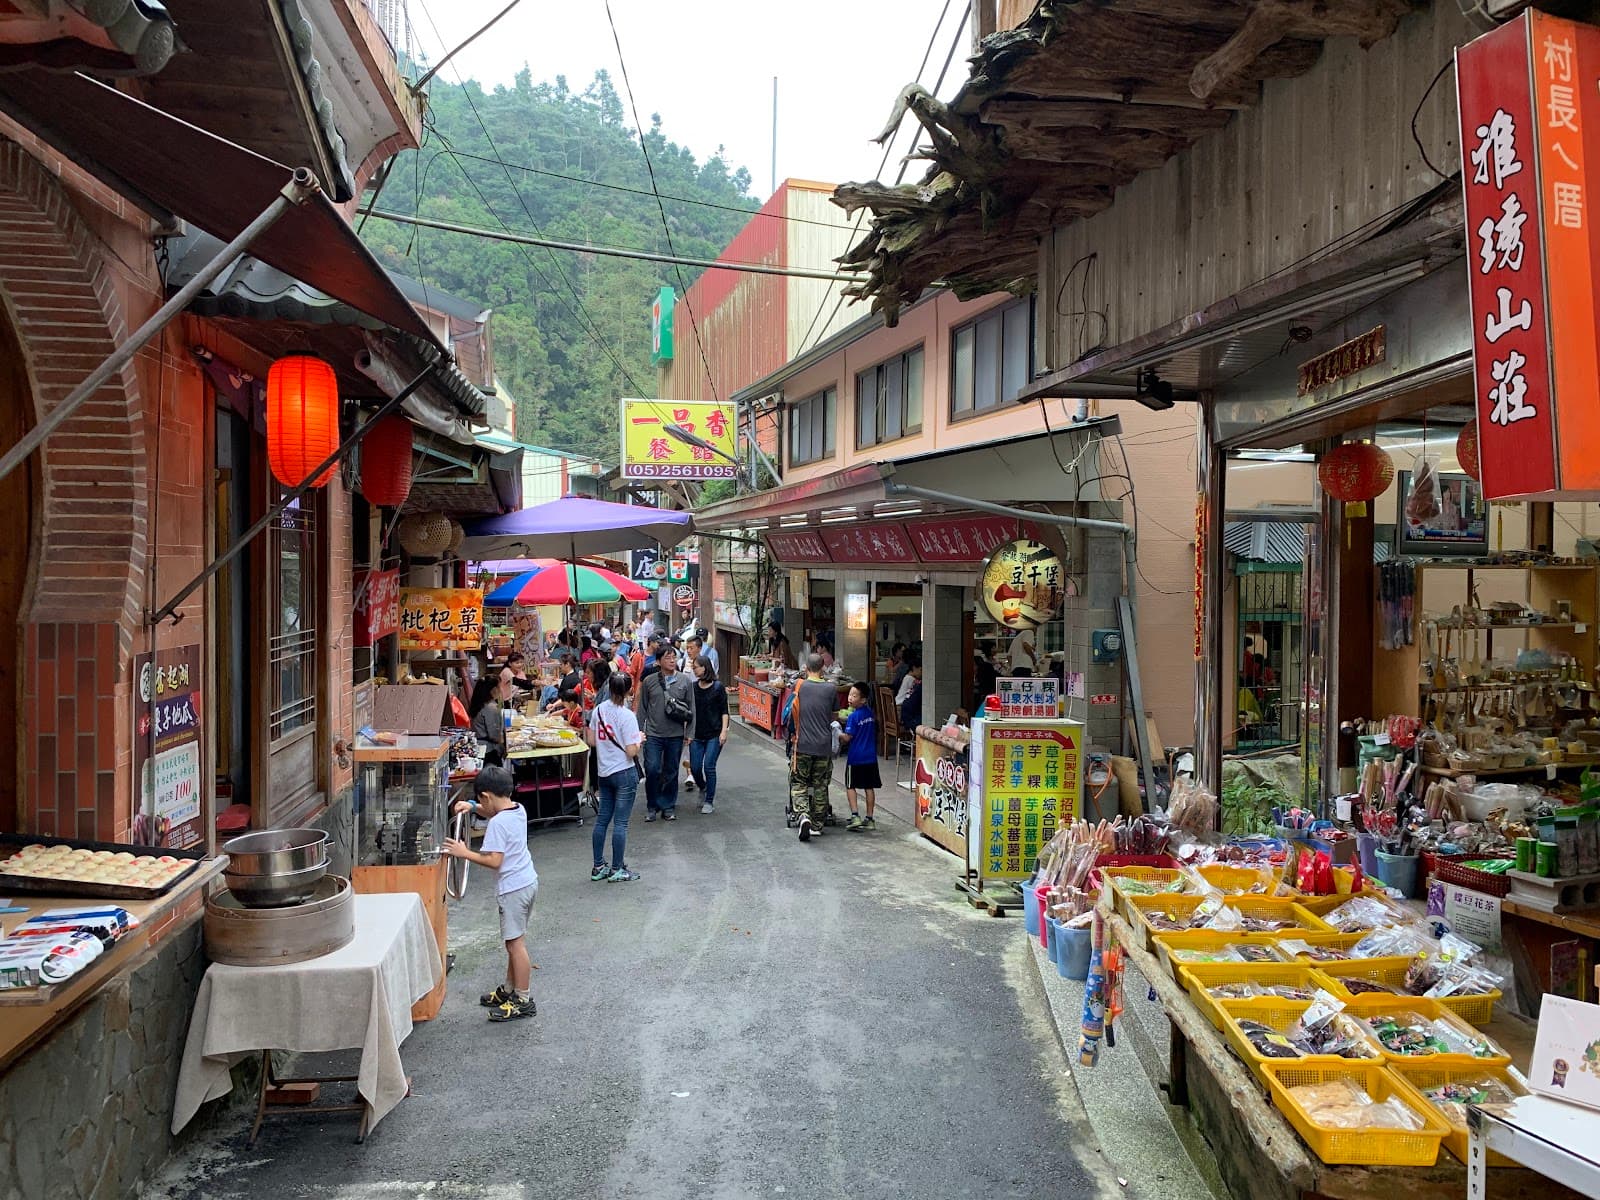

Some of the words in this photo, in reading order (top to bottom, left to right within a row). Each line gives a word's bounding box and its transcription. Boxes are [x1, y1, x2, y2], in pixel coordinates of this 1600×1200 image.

[628, 465, 734, 477] (05)2561095
[1010, 565, 1058, 587] 豆干堡
[999, 681, 1056, 692] 草仔粿
[991, 744, 1006, 788] 薑母茶
[1010, 745, 1024, 788] 冷凍芋
[1045, 745, 1060, 789] 草仔粿
